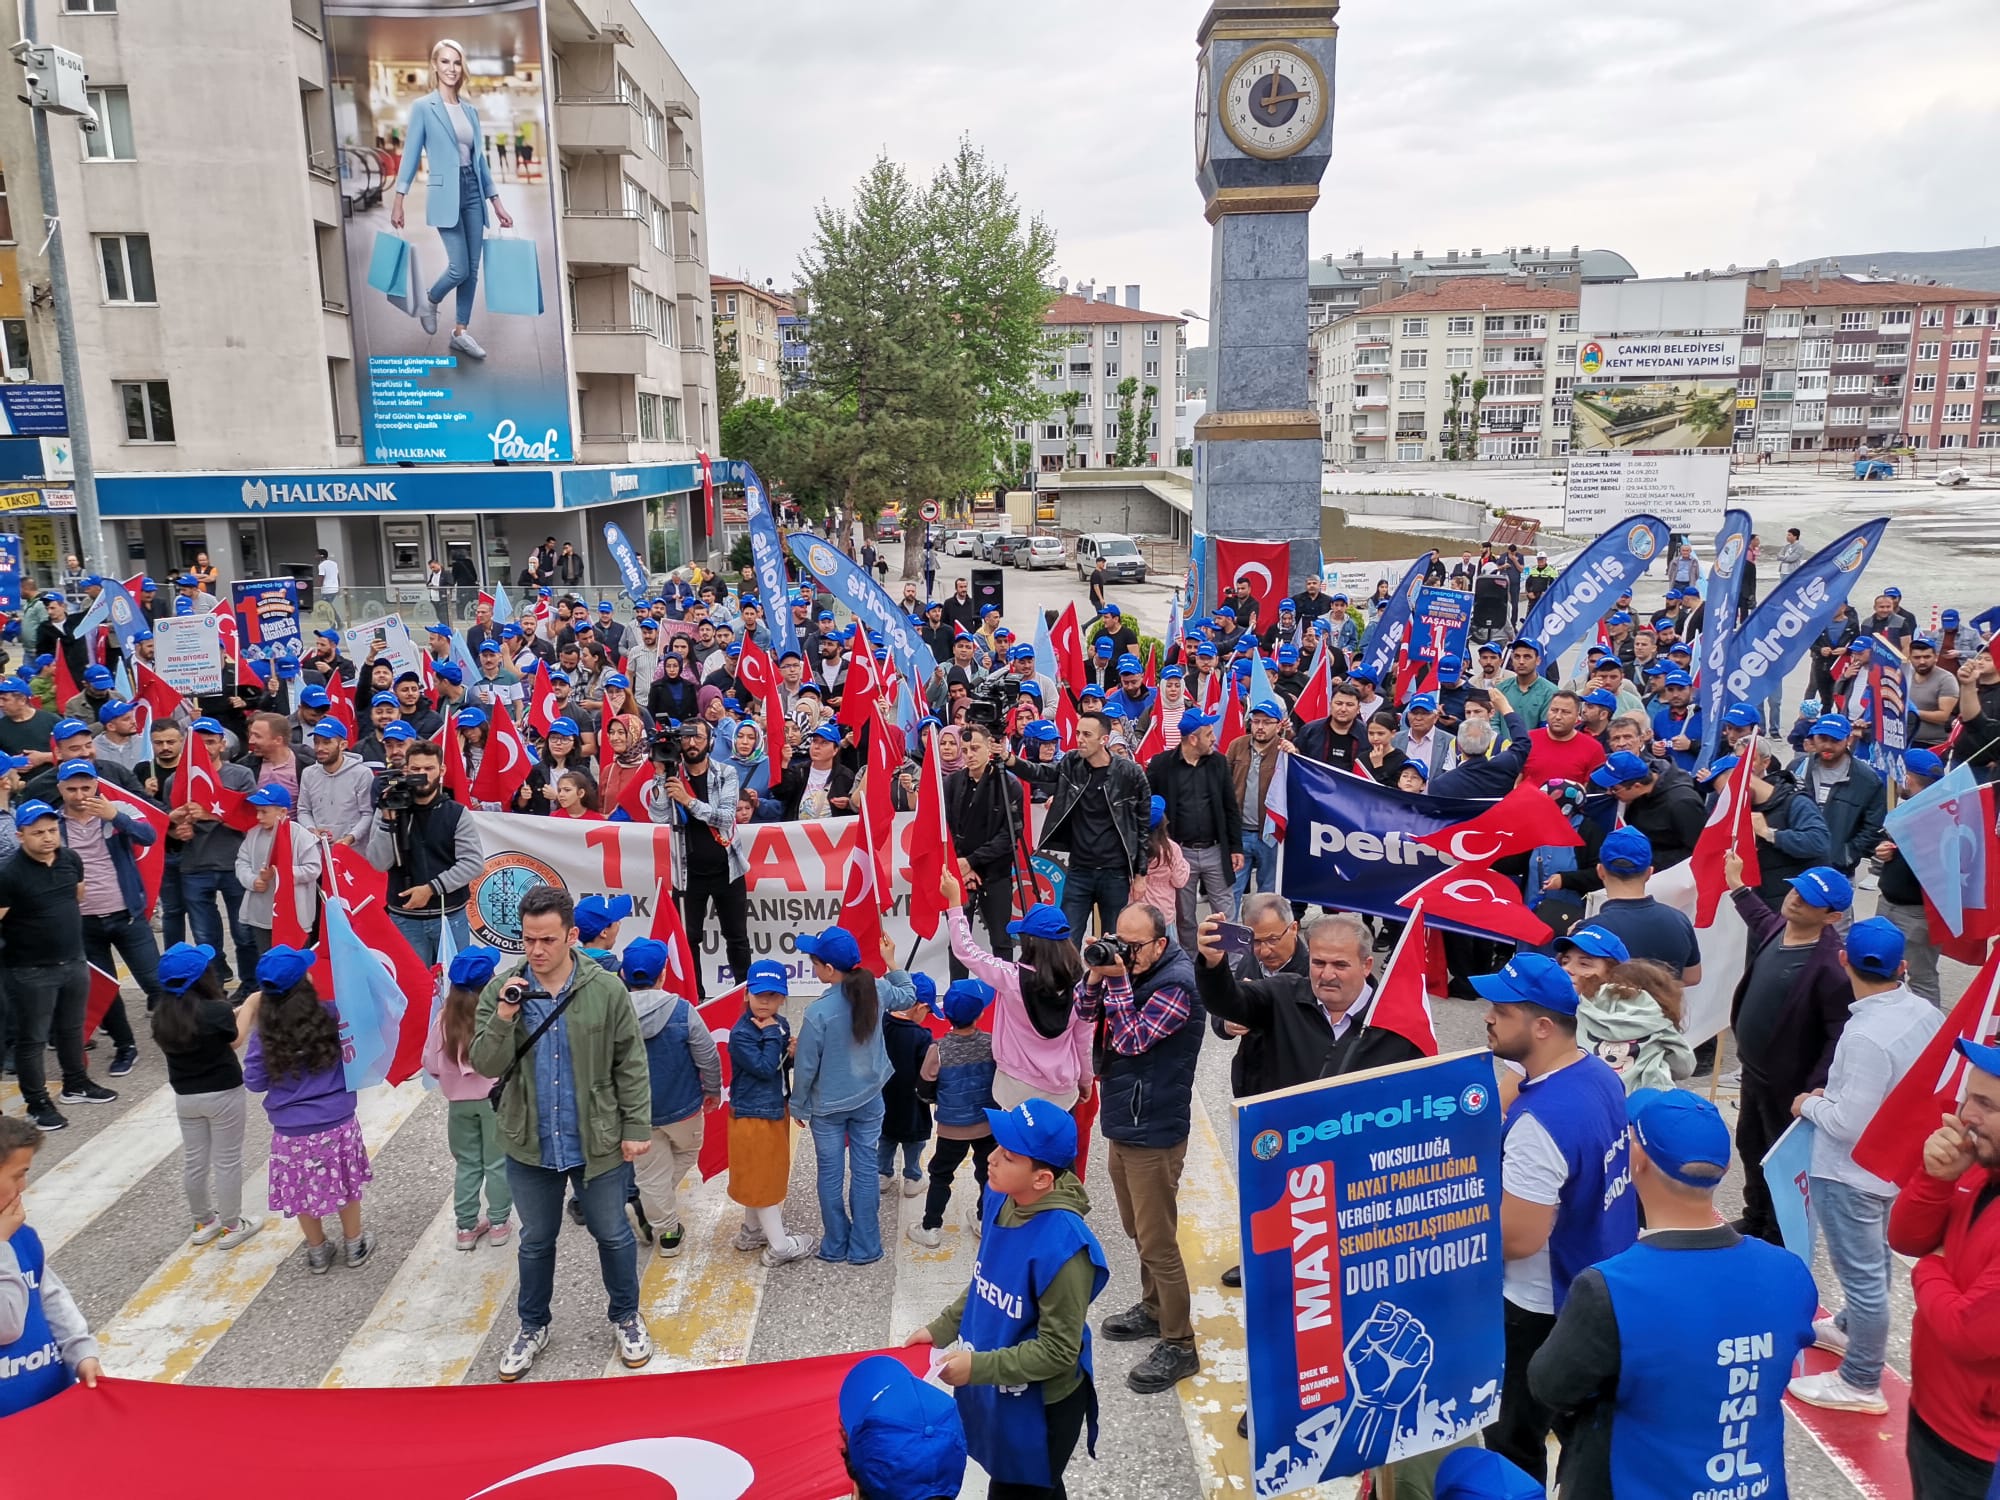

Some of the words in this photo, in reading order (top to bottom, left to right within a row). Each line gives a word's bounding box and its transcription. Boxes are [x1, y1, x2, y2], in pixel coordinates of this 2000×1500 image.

[1253, 65, 1262, 75] 11
[1290, 64, 1294, 74] 1
[1240, 79, 1251, 88] 10
[1301, 76, 1307, 86] 2
[1235, 96, 1241, 105] 9
[1305, 93, 1311, 105] 3
[1240, 114, 1246, 123] 8
[1300, 114, 1305, 123] 4
[1252, 127, 1257, 137] 7
[1269, 134, 1275, 142] 6
[1286, 128, 1292, 137] 5
[1618, 345, 1662, 355] ÇANKIRI
[1664, 342, 1725, 354] BELEDİYESİ
[404, 358, 434, 366] günlerine
[1606, 359, 1634, 368] KENT
[1636, 358, 1684, 368] MEYDANI
[1685, 357, 1719, 366] YAPIM
[1722, 355, 1735, 366] İŞİ
[389, 449, 447, 458] HALKBANK
[270, 482, 398, 503] HALKBANK
[236, 596, 262, 644] 1
[1421, 615, 1462, 628] YAŞASIN
[1727, 576, 1830, 701] petrol-iş
[586, 826, 623, 889] 1
[1288, 1095, 1457, 1154] petrol-iş
[1369, 1138, 1451, 1172] YOKSULLUĞA
[1347, 1175, 1388, 1202] HAYAT
[1390, 1155, 1478, 1192] PAHALILIĞINA
[1337, 1200, 1392, 1230] VERGİDE
[1395, 1178, 1485, 1217] ADALETSİZLİĞE
[1339, 1203, 1490, 1257] SENDİKASIZLAŞTIRMAYA
[1289, 1164, 1332, 1333] MAYIS
[1346, 1258, 1389, 1296] DUR
[1395, 1232, 1488, 1283] DİYORUZ!
[1250, 1160, 1347, 1411] 1
[1717, 1332, 1773, 1366] SEN
[1299, 1368, 1318, 1380] EMEK
[1319, 1366, 1329, 1375] VE
[1728, 1365, 1759, 1395] Dİ
[1300, 1375, 1340, 1393] DAYANIŞMA
[1301, 1393, 1321, 1406] GÜNÜ
[1719, 1395, 1757, 1425] KA
[1722, 1421, 1748, 1449] LI
[1706, 1449, 1762, 1483] OL
